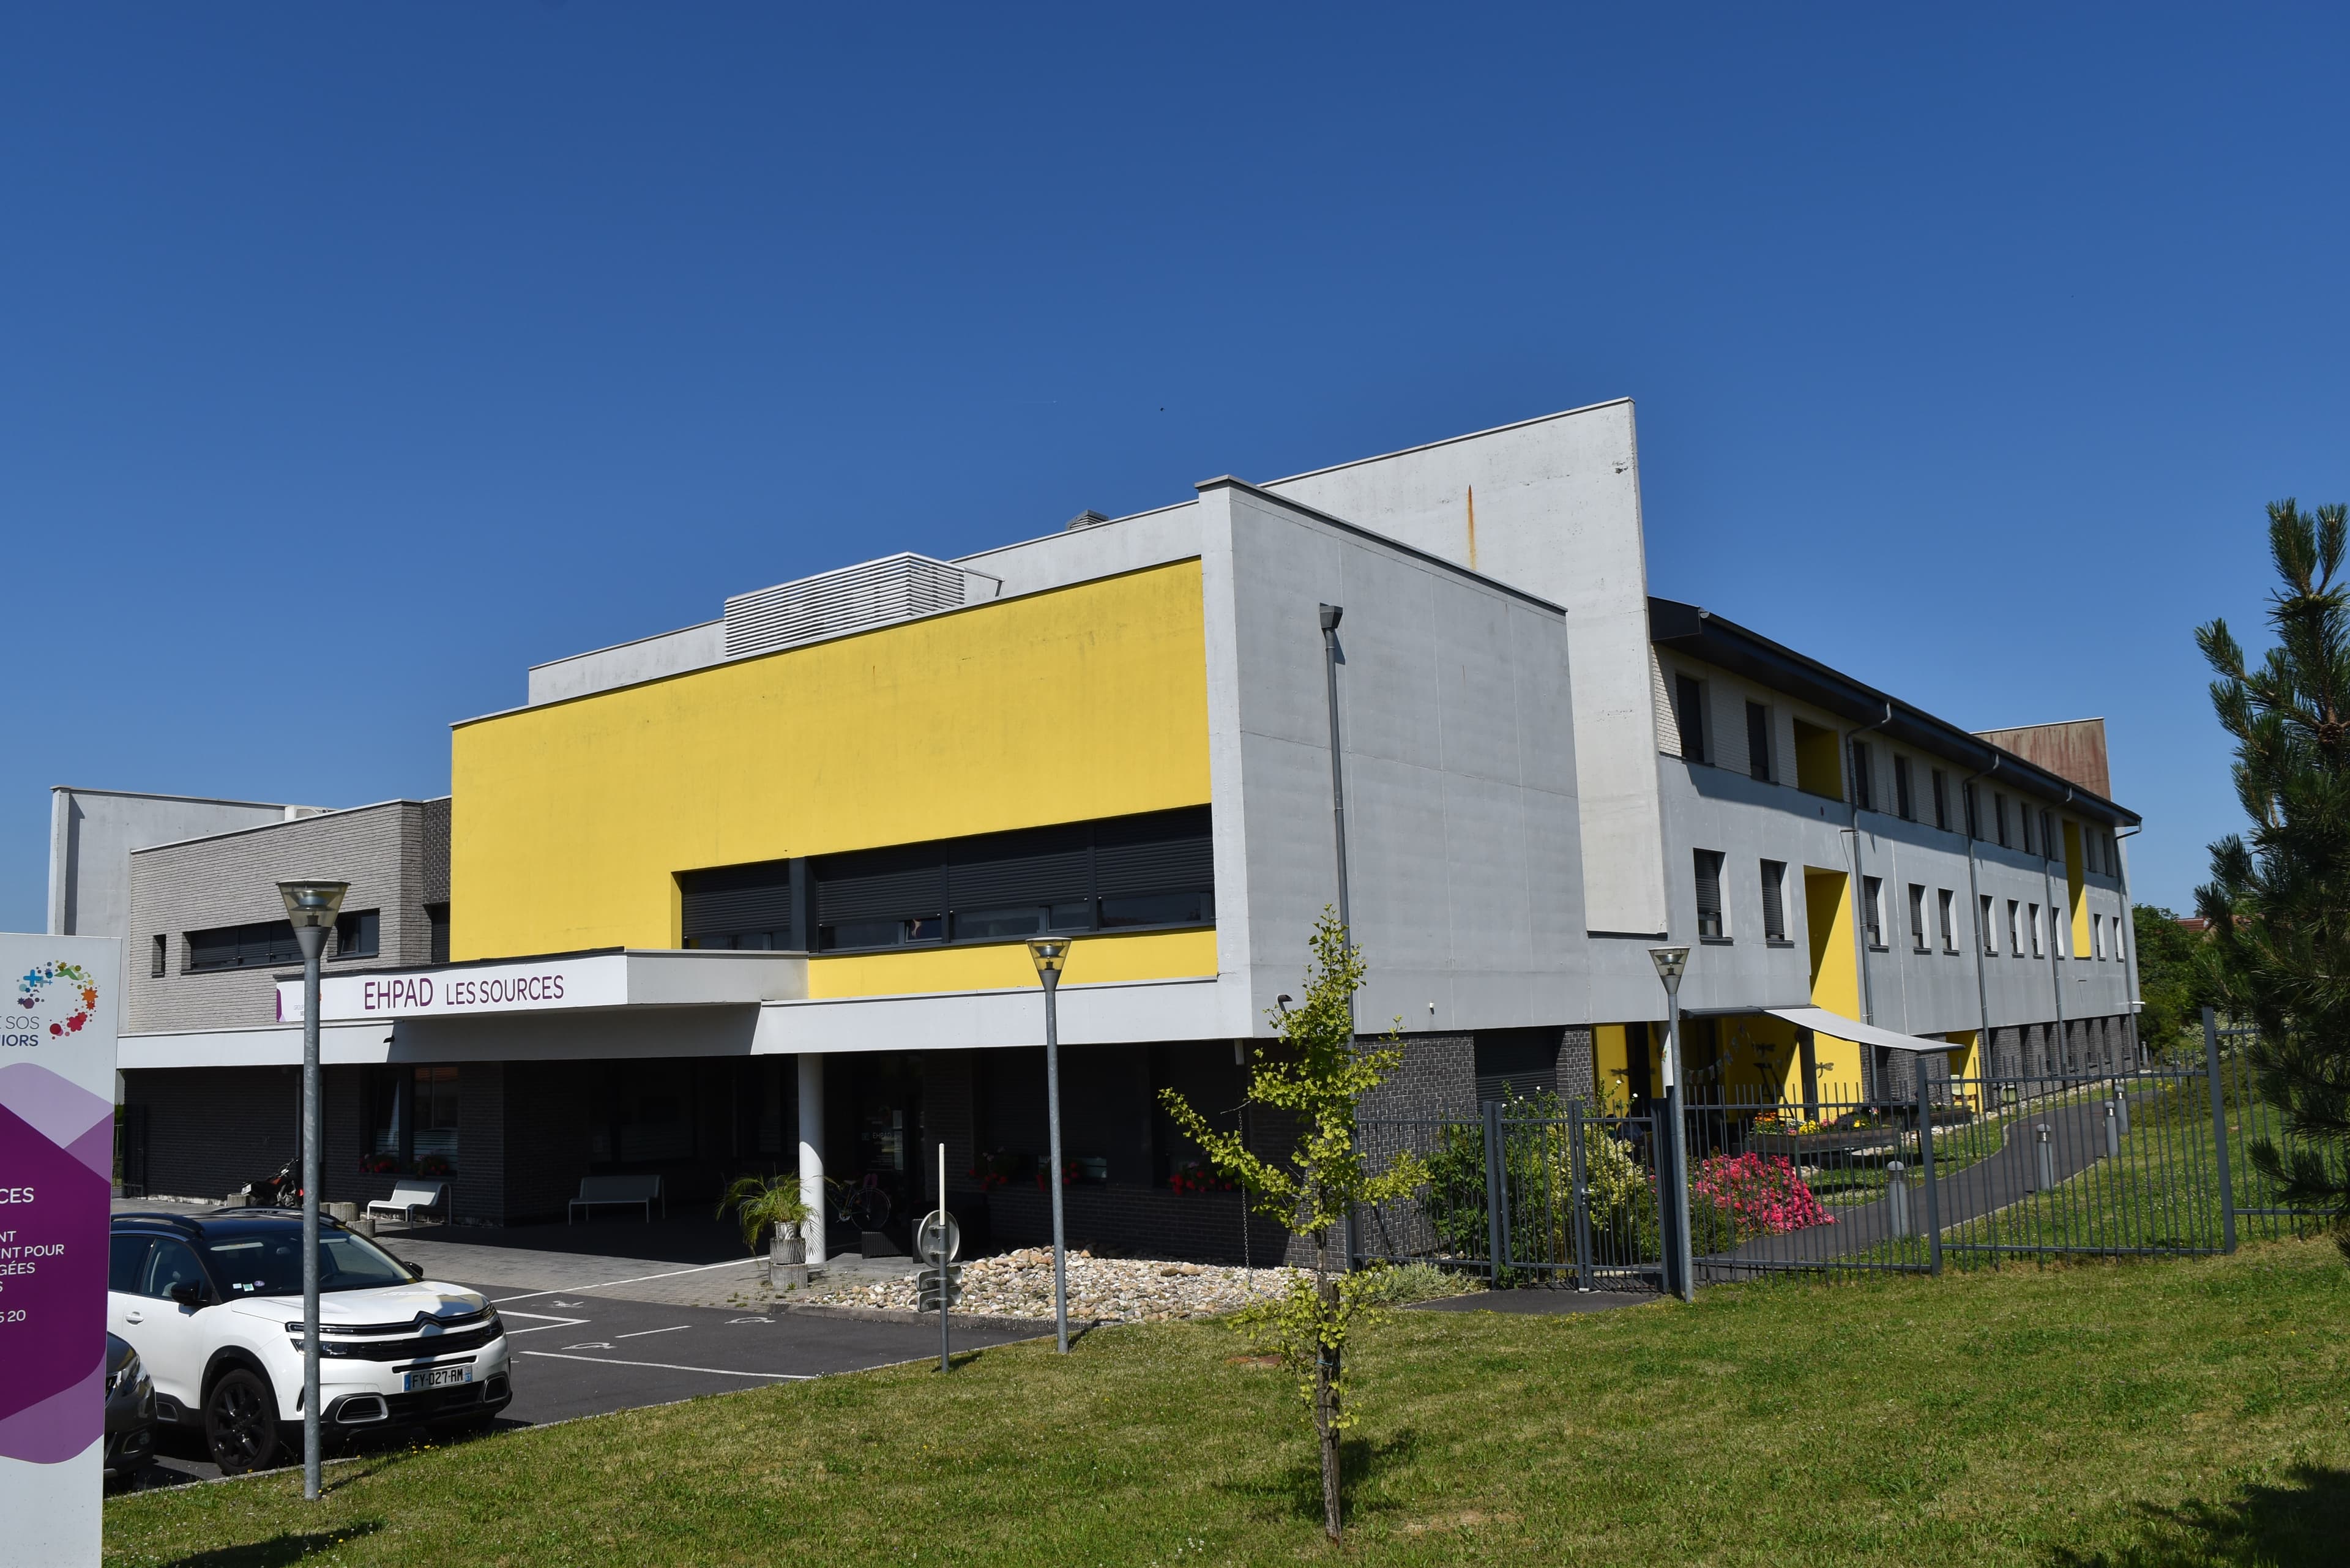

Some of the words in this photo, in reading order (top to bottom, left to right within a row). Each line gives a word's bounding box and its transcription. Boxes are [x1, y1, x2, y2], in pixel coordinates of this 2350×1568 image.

[365, 978, 433, 1010] EHPAD
[446, 981, 476, 1005] LES
[480, 975, 564, 1003] SOURCES
[6, 1015, 39, 1029] SOS
[0, 1034, 39, 1047] IORS
[0, 1247, 22, 1259] NT
[24, 1244, 64, 1258] POUR
[0, 1260, 35, 1276] GÉES
[7, 1310, 26, 1322] 20
[412, 1368, 463, 1387] FY-027-RM
